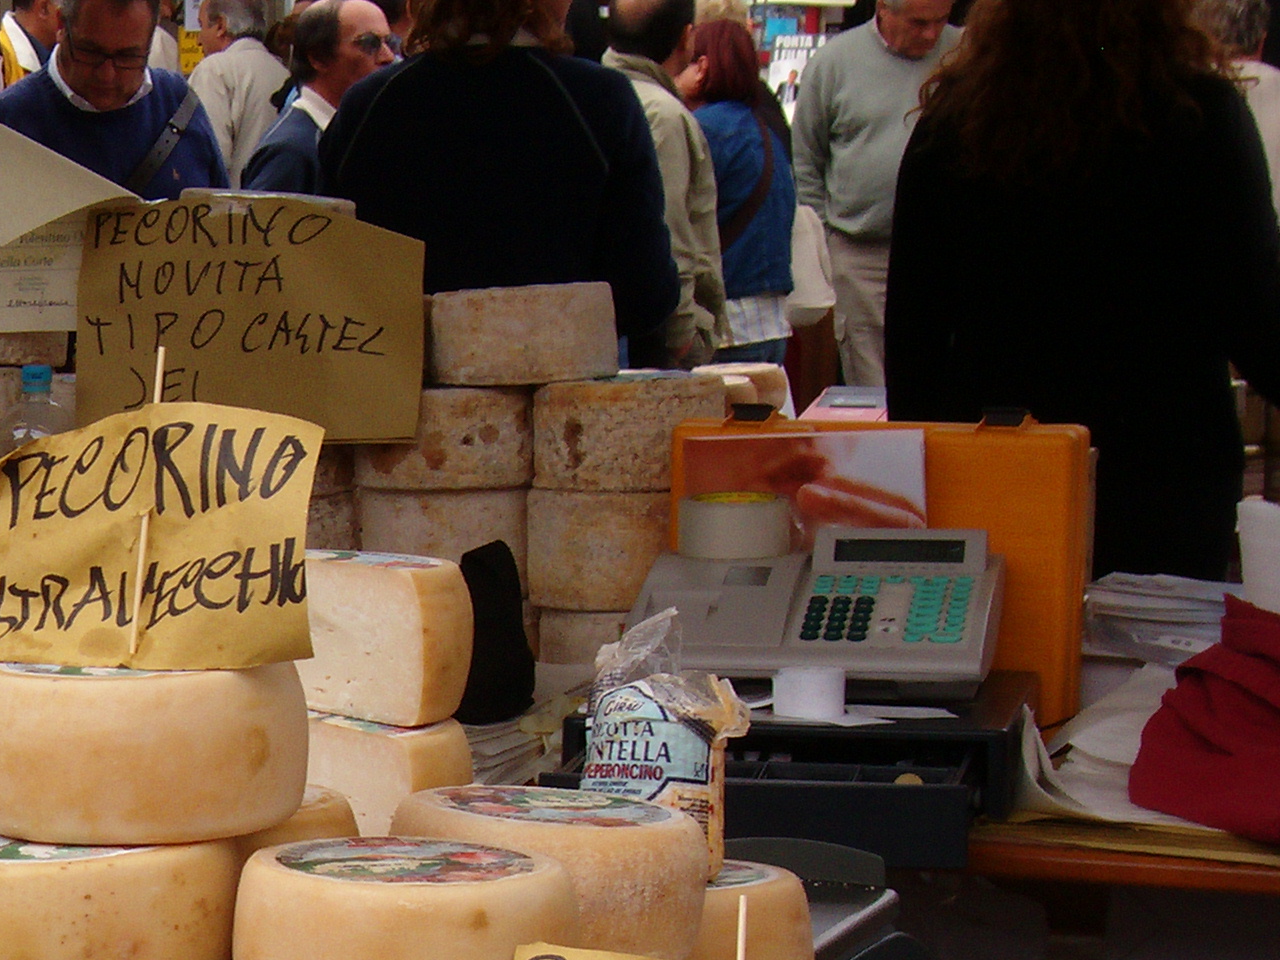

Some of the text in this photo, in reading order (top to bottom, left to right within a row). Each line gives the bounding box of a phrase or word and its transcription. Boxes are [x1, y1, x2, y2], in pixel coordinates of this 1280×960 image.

[93, 202, 333, 249] PECORINO
[119, 255, 284, 304] NOVITA
[85, 309, 225, 356] TIPO
[1, 421, 308, 531] PECORINO
